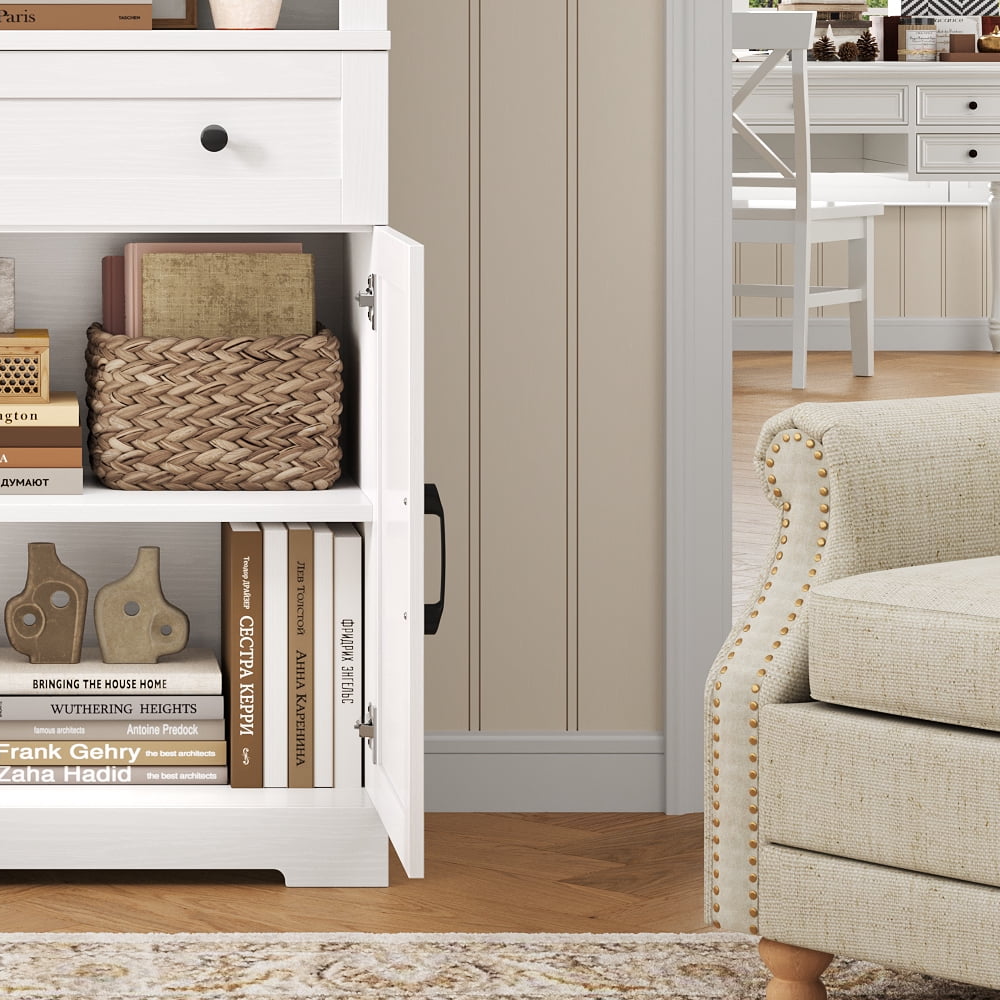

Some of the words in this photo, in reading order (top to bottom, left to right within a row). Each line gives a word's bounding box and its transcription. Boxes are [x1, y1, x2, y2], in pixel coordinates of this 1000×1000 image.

[0, 478, 50, 488] ДУМАЮТ
[242, 556, 250, 580] Теодор
[242, 580, 251, 610] ДРАЙЗЕР
[239, 615, 255, 680] СЕСТРА
[340, 618, 354, 662] ФРИДРИХ
[32, 679, 80, 689] BRINGING
[84, 679, 102, 689] THE
[104, 679, 137, 689] HOUSE
[140, 679, 167, 689] HOME
[341, 666, 354, 704] ЭНГЕЛЬС
[50, 704, 133, 714] WUTHERING
[140, 704, 197, 714] HEIGHTS
[239, 682, 255, 736] КЕРРИ
[34, 726, 56, 735] famous
[56, 726, 86, 735] architects
[126, 723, 160, 736] Antoine
[162, 723, 199, 736] Predock
[69, 743, 141, 764] Gehry
[64, 766, 132, 782] Hadid
